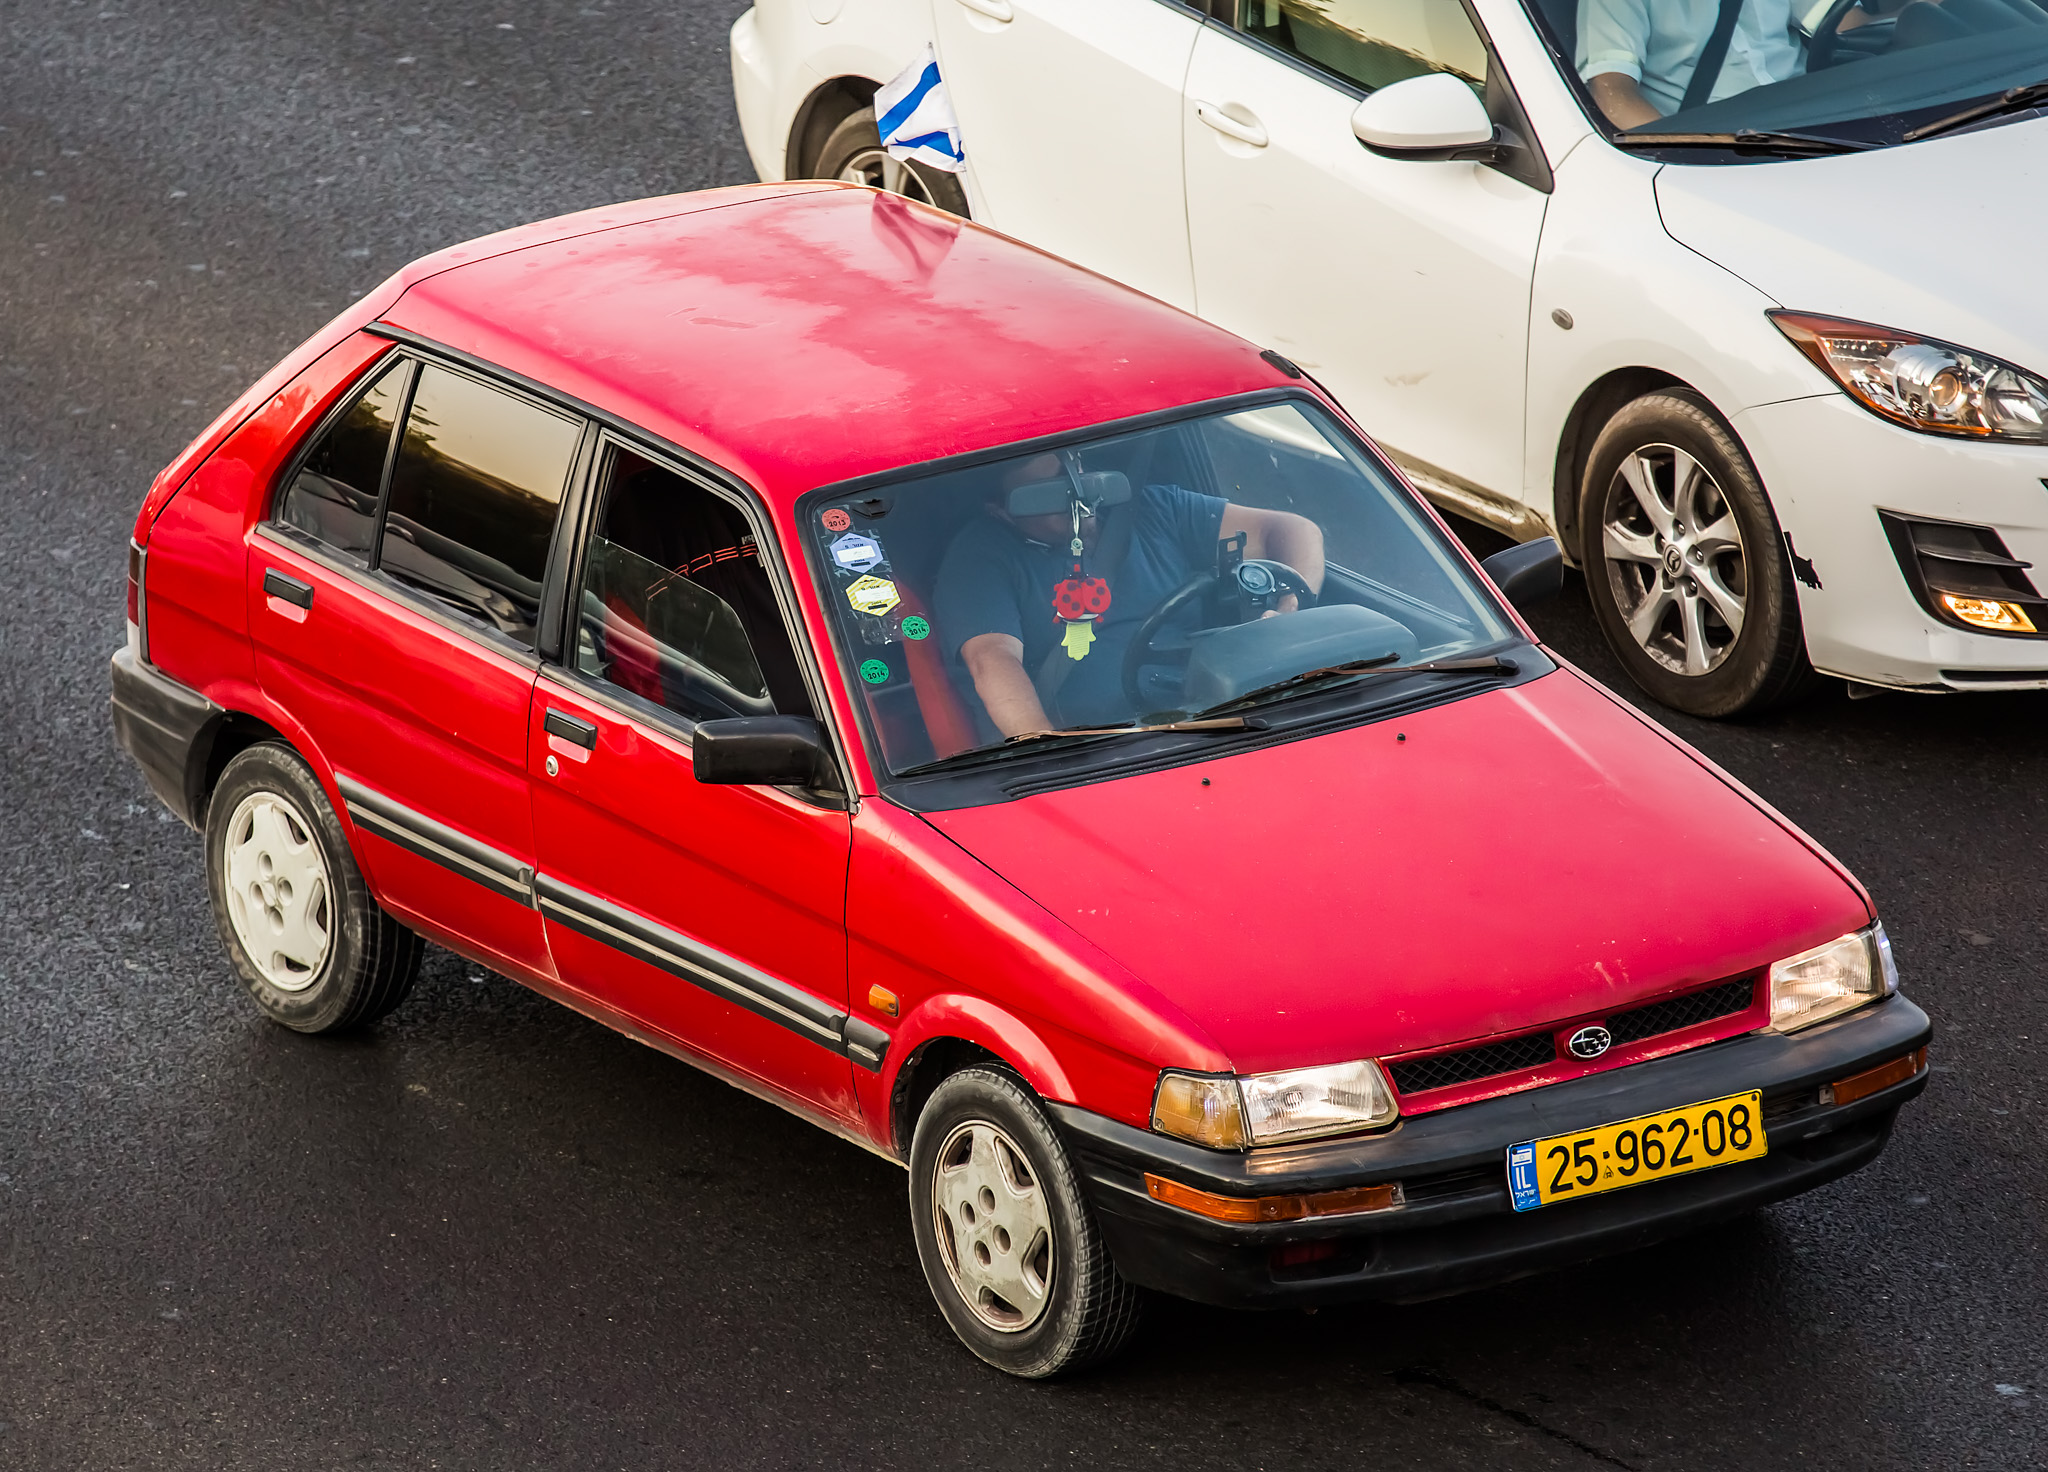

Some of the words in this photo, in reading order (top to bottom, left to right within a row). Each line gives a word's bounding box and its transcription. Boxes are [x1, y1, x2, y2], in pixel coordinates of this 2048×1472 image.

[909, 627, 927, 636] 2014
[867, 671, 886, 680] 2014
[1515, 1166, 1532, 1190] IL
